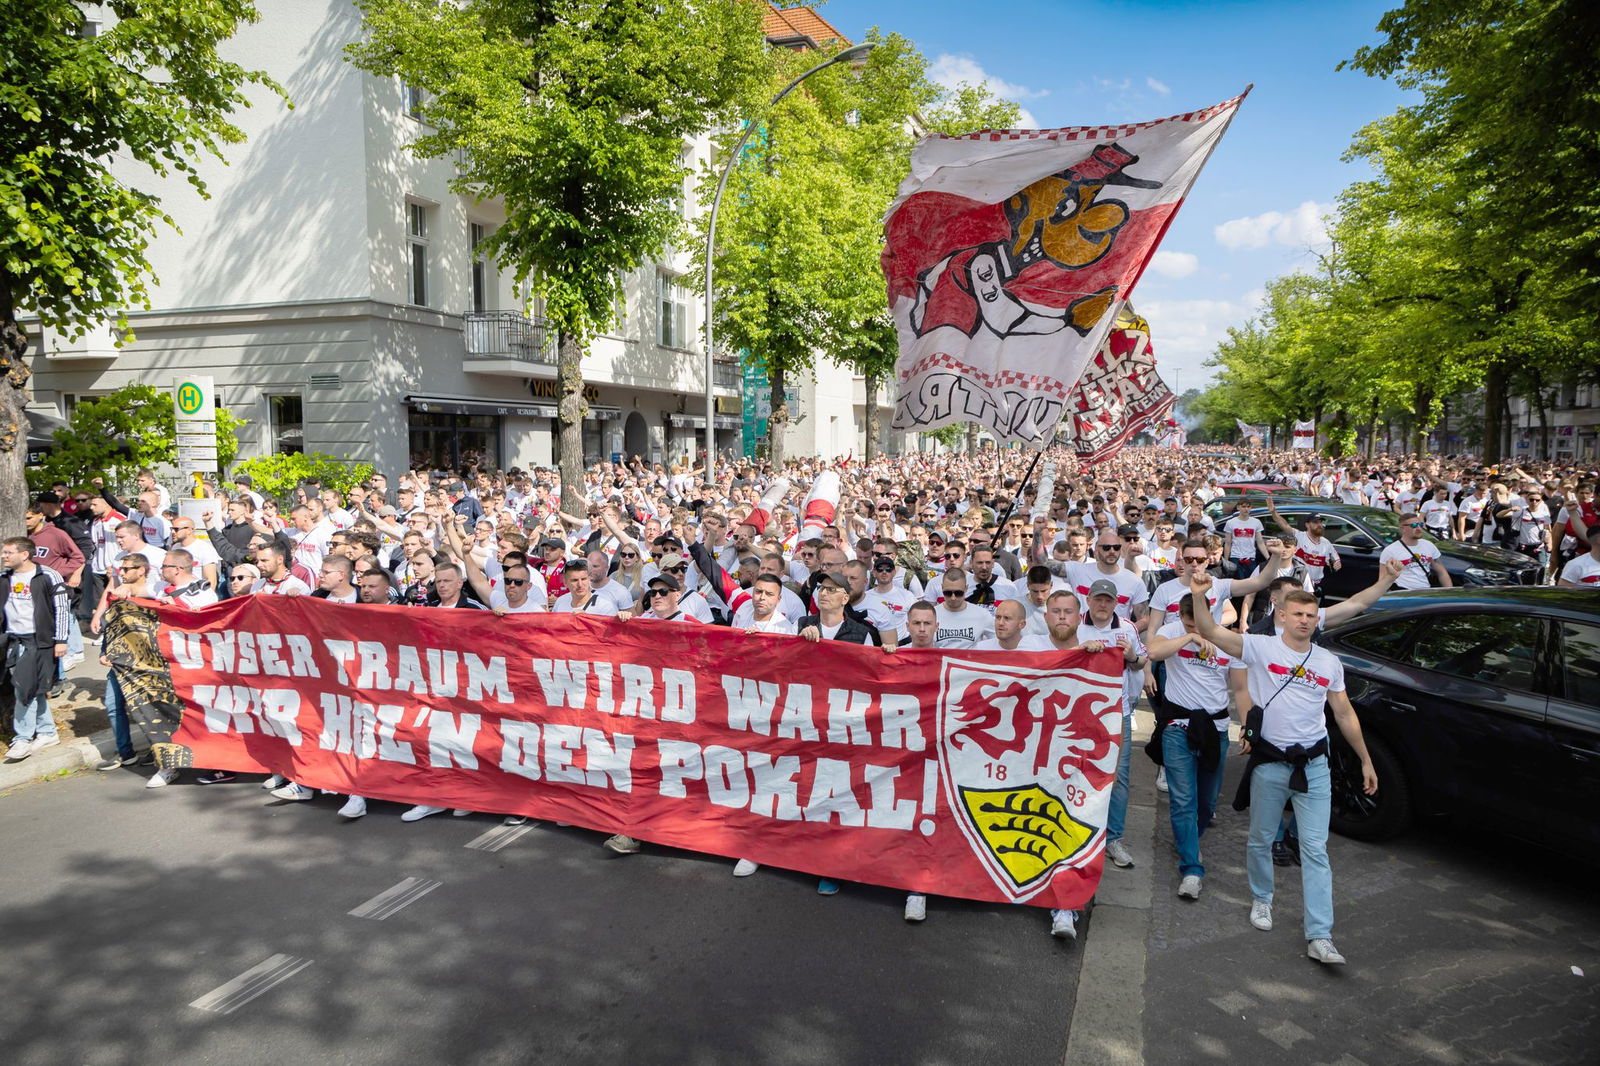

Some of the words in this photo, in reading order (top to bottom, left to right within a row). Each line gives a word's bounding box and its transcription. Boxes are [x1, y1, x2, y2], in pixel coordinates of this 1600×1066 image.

[183, 389, 195, 407] H
[936, 627, 976, 642] LONSDALE
[168, 629, 321, 679] UNSER
[322, 638, 515, 703] TRAUM
[533, 657, 697, 724] WIRD
[721, 674, 926, 751] WAHR
[192, 684, 303, 746] WIR
[318, 692, 482, 770] HOL'N
[499, 718, 635, 793] DEN
[657, 738, 939, 836] POKAL!
[984, 762, 1008, 781] 18
[1066, 784, 1087, 808] 93
